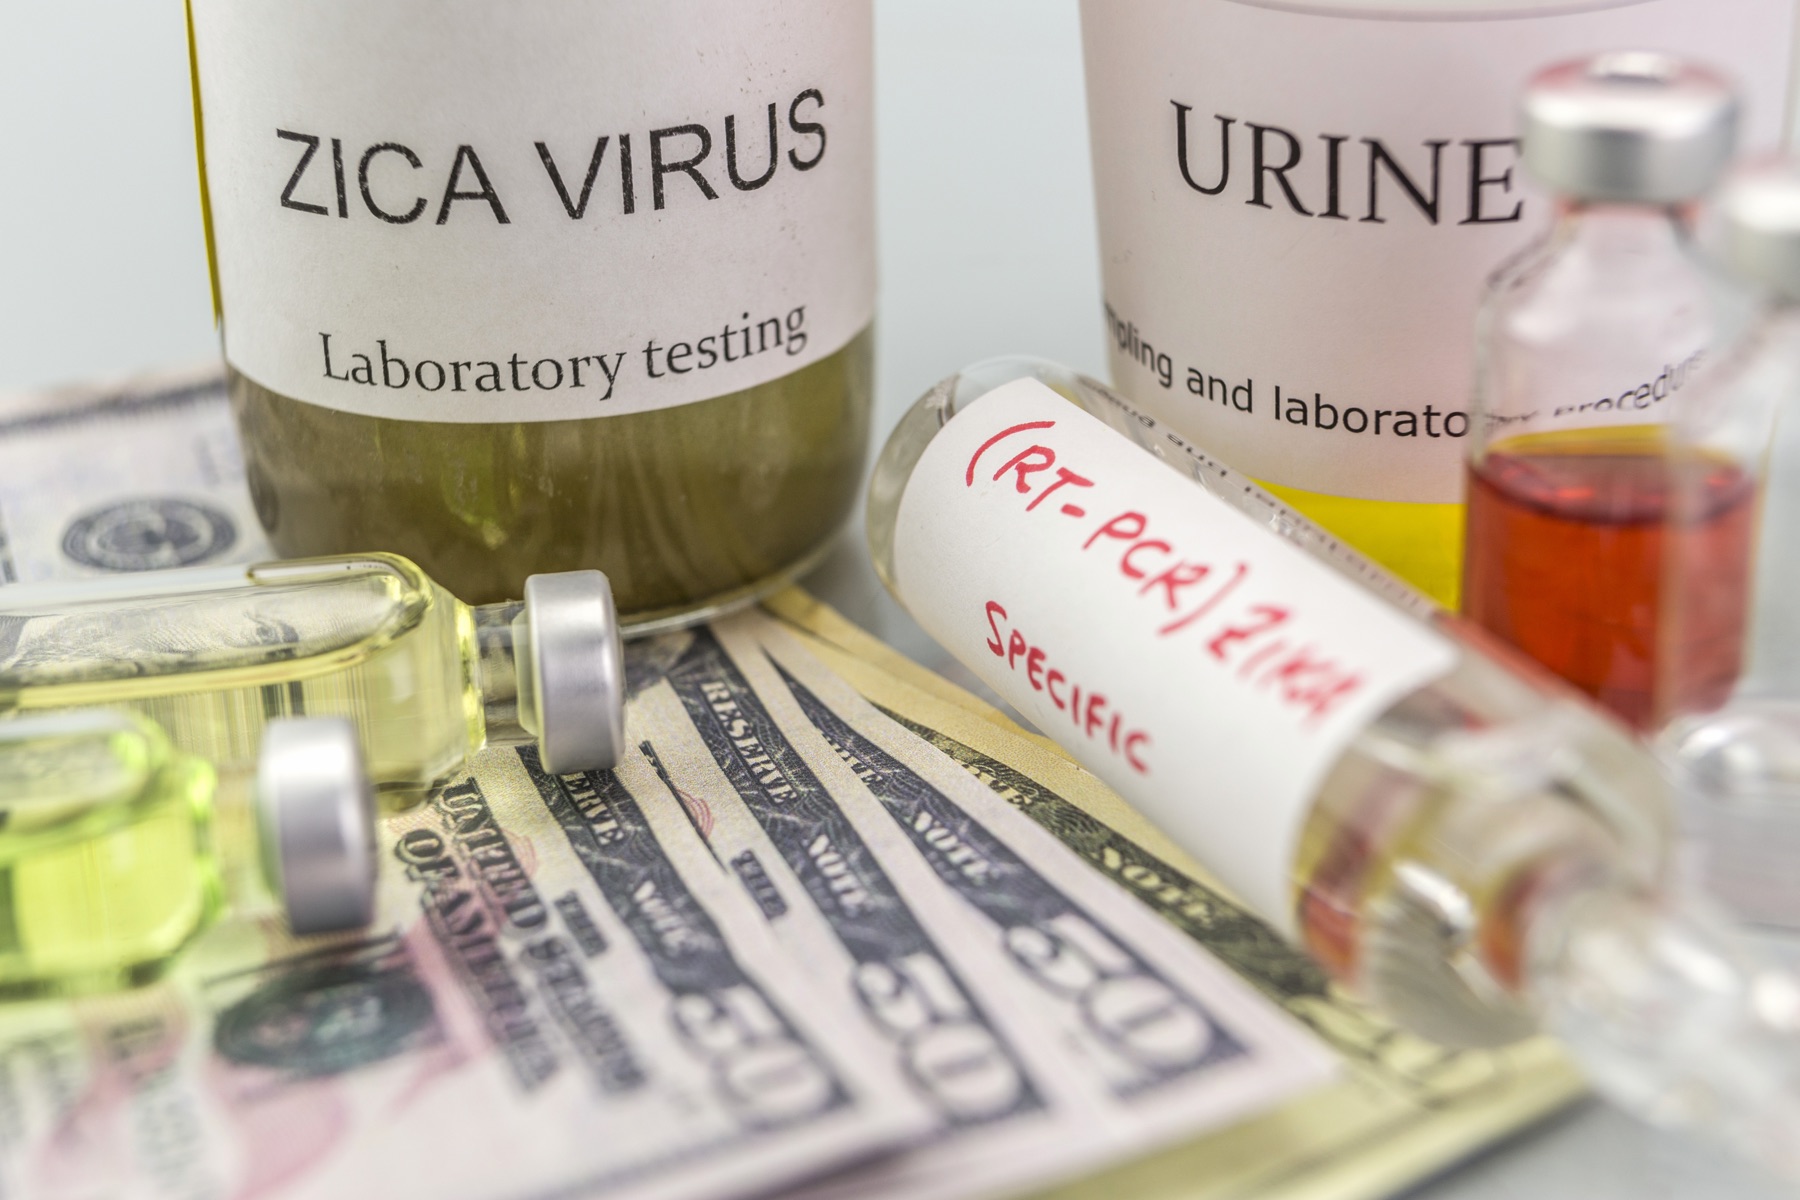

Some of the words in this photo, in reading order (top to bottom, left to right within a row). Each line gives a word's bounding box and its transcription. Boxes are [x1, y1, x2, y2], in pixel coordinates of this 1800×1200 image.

[275, 127, 511, 226] ZICA
[533, 87, 828, 222] VIRUS
[1169, 99, 1524, 226] URINE
[317, 331, 627, 401] Laboratory
[641, 304, 809, 380] testing
[1186, 366, 1253, 414] and
[699, 682, 798, 805] RESERVE
[984, 600, 1152, 776] SPECIFIC
[852, 950, 1030, 1124] 50
[1000, 910, 1213, 1073] 50
